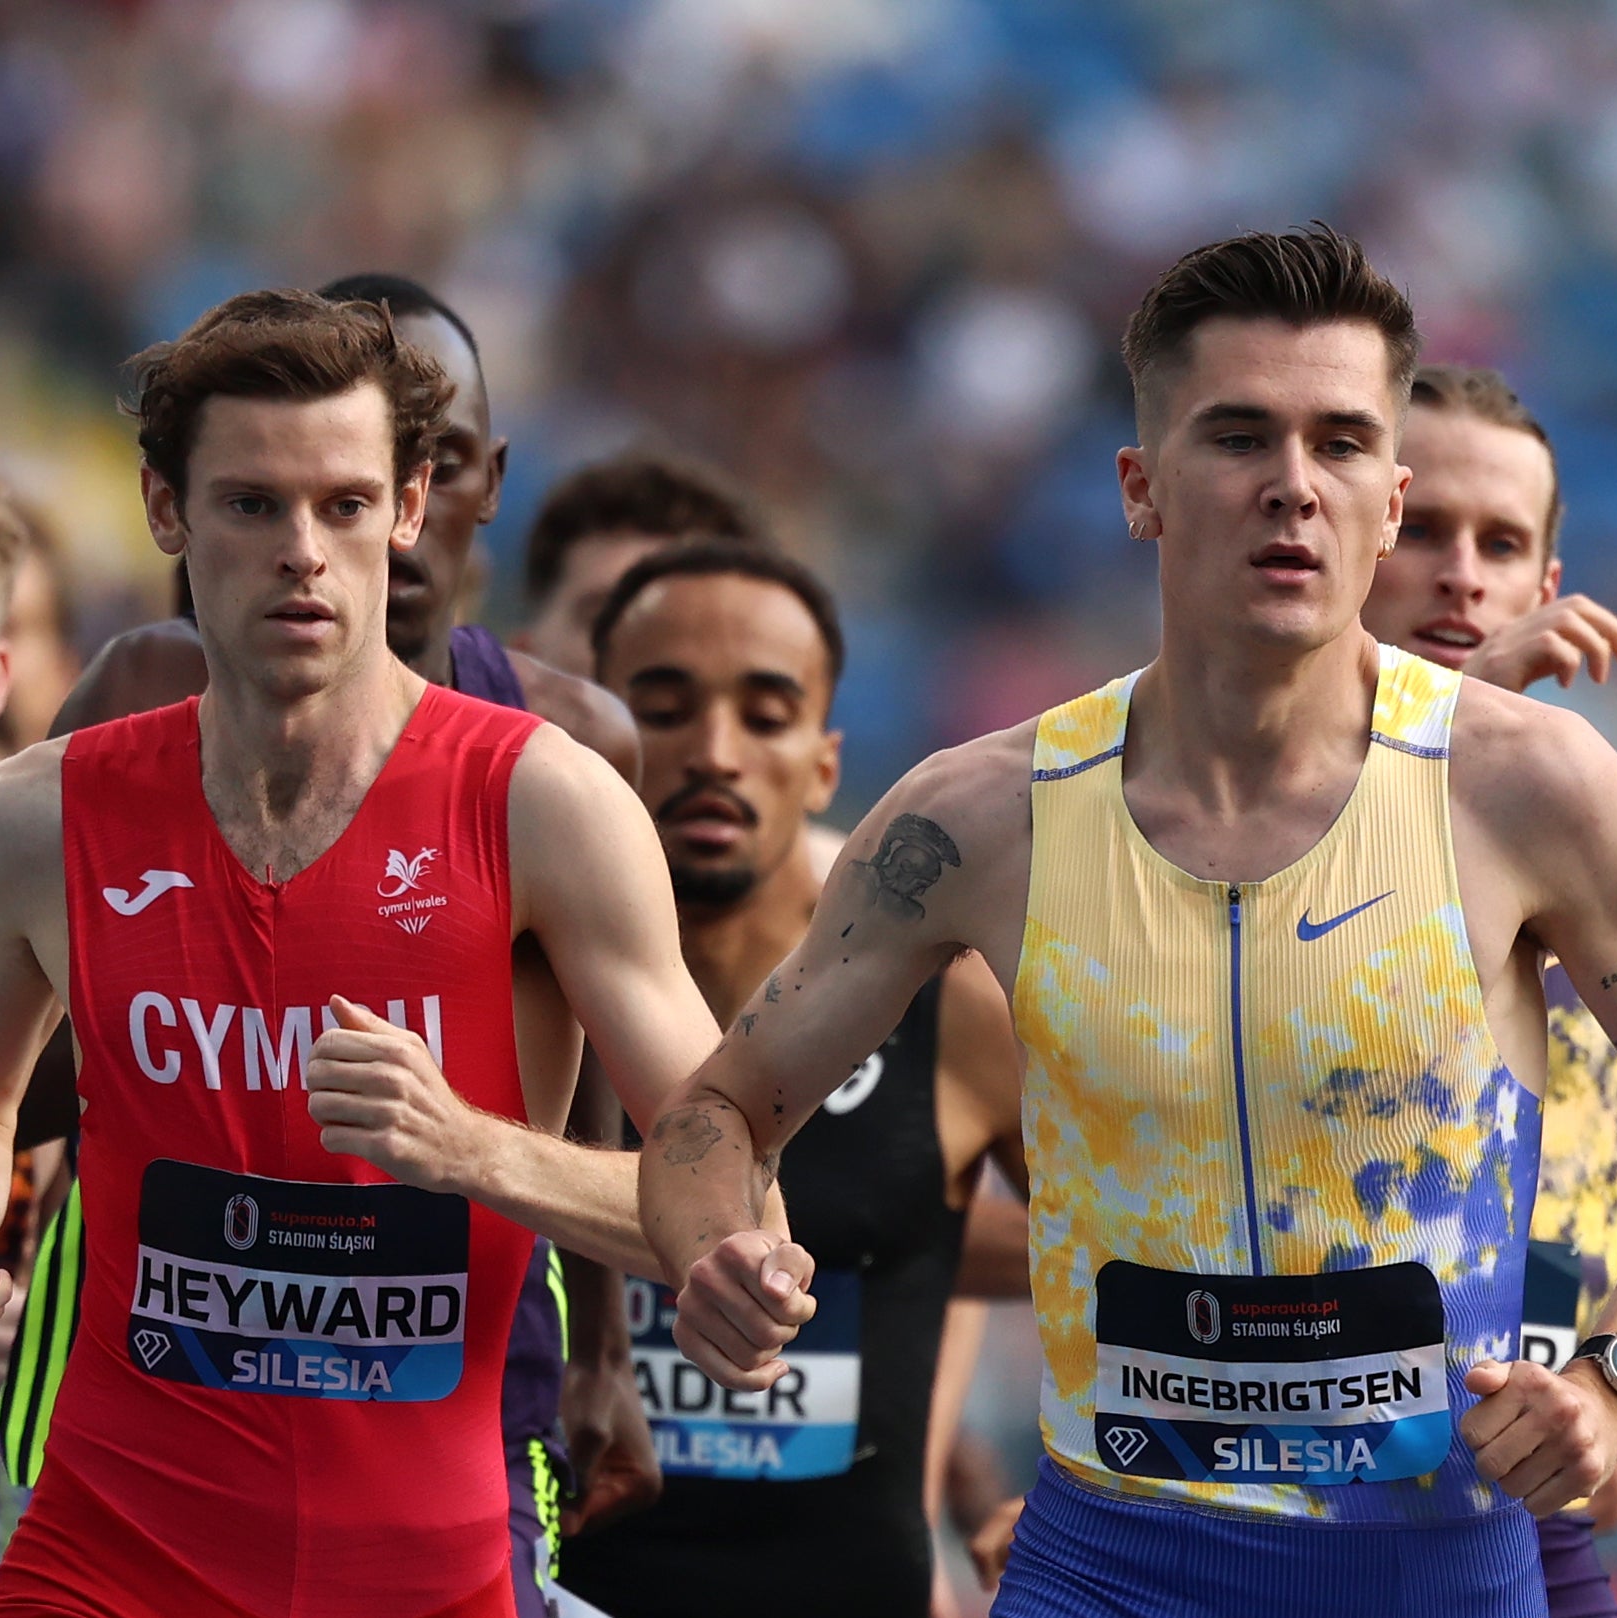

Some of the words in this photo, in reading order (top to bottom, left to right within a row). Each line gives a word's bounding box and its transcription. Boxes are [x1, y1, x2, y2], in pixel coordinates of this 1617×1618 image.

[377, 901, 411, 918] cymru
[415, 894, 448, 909] wales
[270, 1210, 377, 1230] superauto.pl
[268, 1229, 326, 1249] STADION
[329, 1231, 376, 1255] ŚLĄSKI
[137, 1255, 461, 1339] HEYWARD
[1231, 1299, 1339, 1318] superauto.pl
[1232, 1322, 1290, 1337] STADION
[1293, 1318, 1341, 1340] ŚLĄSKI
[232, 1349, 393, 1393] SILESIA
[634, 1361, 807, 1417] ADER
[1121, 1364, 1422, 1412] INGEBRIGTSEN
[1212, 1436, 1377, 1474] SILESIA
